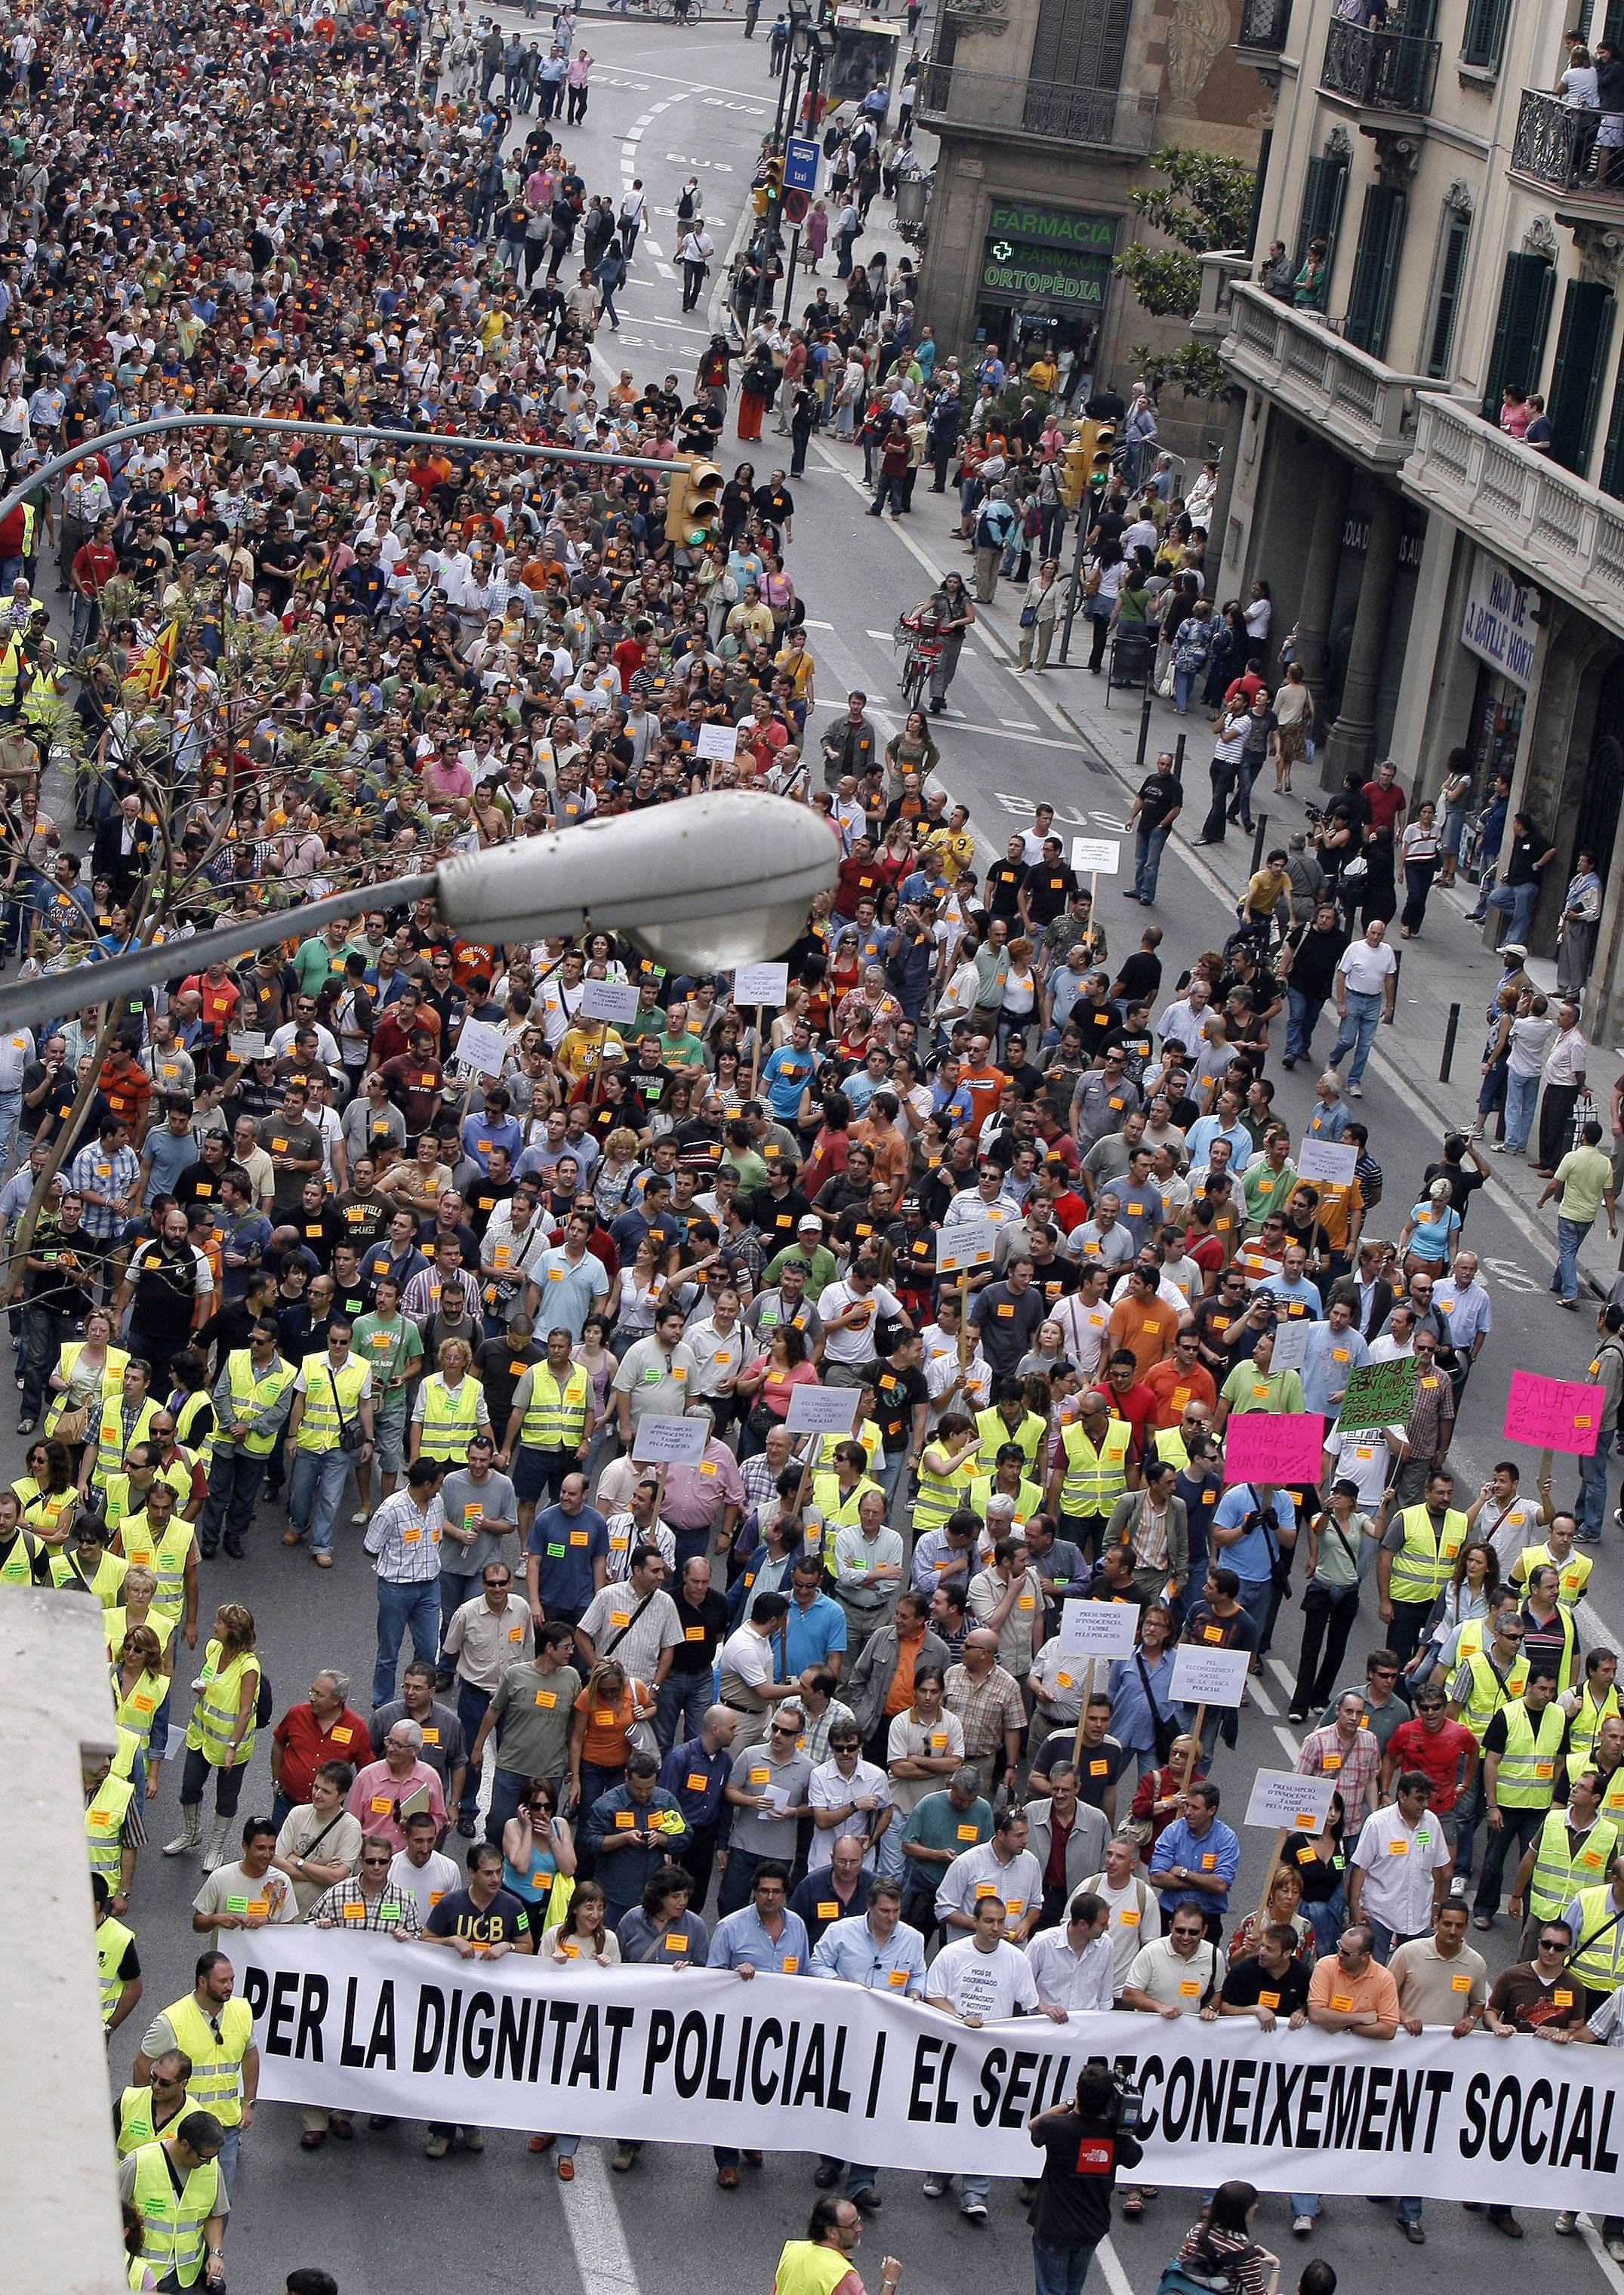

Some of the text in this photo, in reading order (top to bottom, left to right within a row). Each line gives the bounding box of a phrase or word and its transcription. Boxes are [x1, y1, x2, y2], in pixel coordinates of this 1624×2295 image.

[587, 75, 652, 91] BUS
[701, 97, 766, 116] BUS
[666, 152, 733, 173] BUS
[793, 170, 807, 182] taxi
[653, 205, 726, 226] BS
[992, 209, 1112, 245] FARMÀCIA
[984, 266, 1102, 302] ORTOPÈDIA
[619, 334, 702, 357] BUS
[994, 793, 1132, 834] BUS
[957, 839, 966, 851] 9
[457, 1914, 504, 1942] UCB
[243, 1966, 329, 2062] PER
[341, 1976, 396, 2070] LA
[411, 1983, 635, 2091] DIGNITAT
[643, 2008, 852, 2114] POLICIAL
[865, 2031, 887, 2119] I
[908, 2034, 959, 2124] EL
[1087, 2054, 1454, 2154] CONEIXEMENT
[1459, 2072, 1619, 2174] SOCIAL
